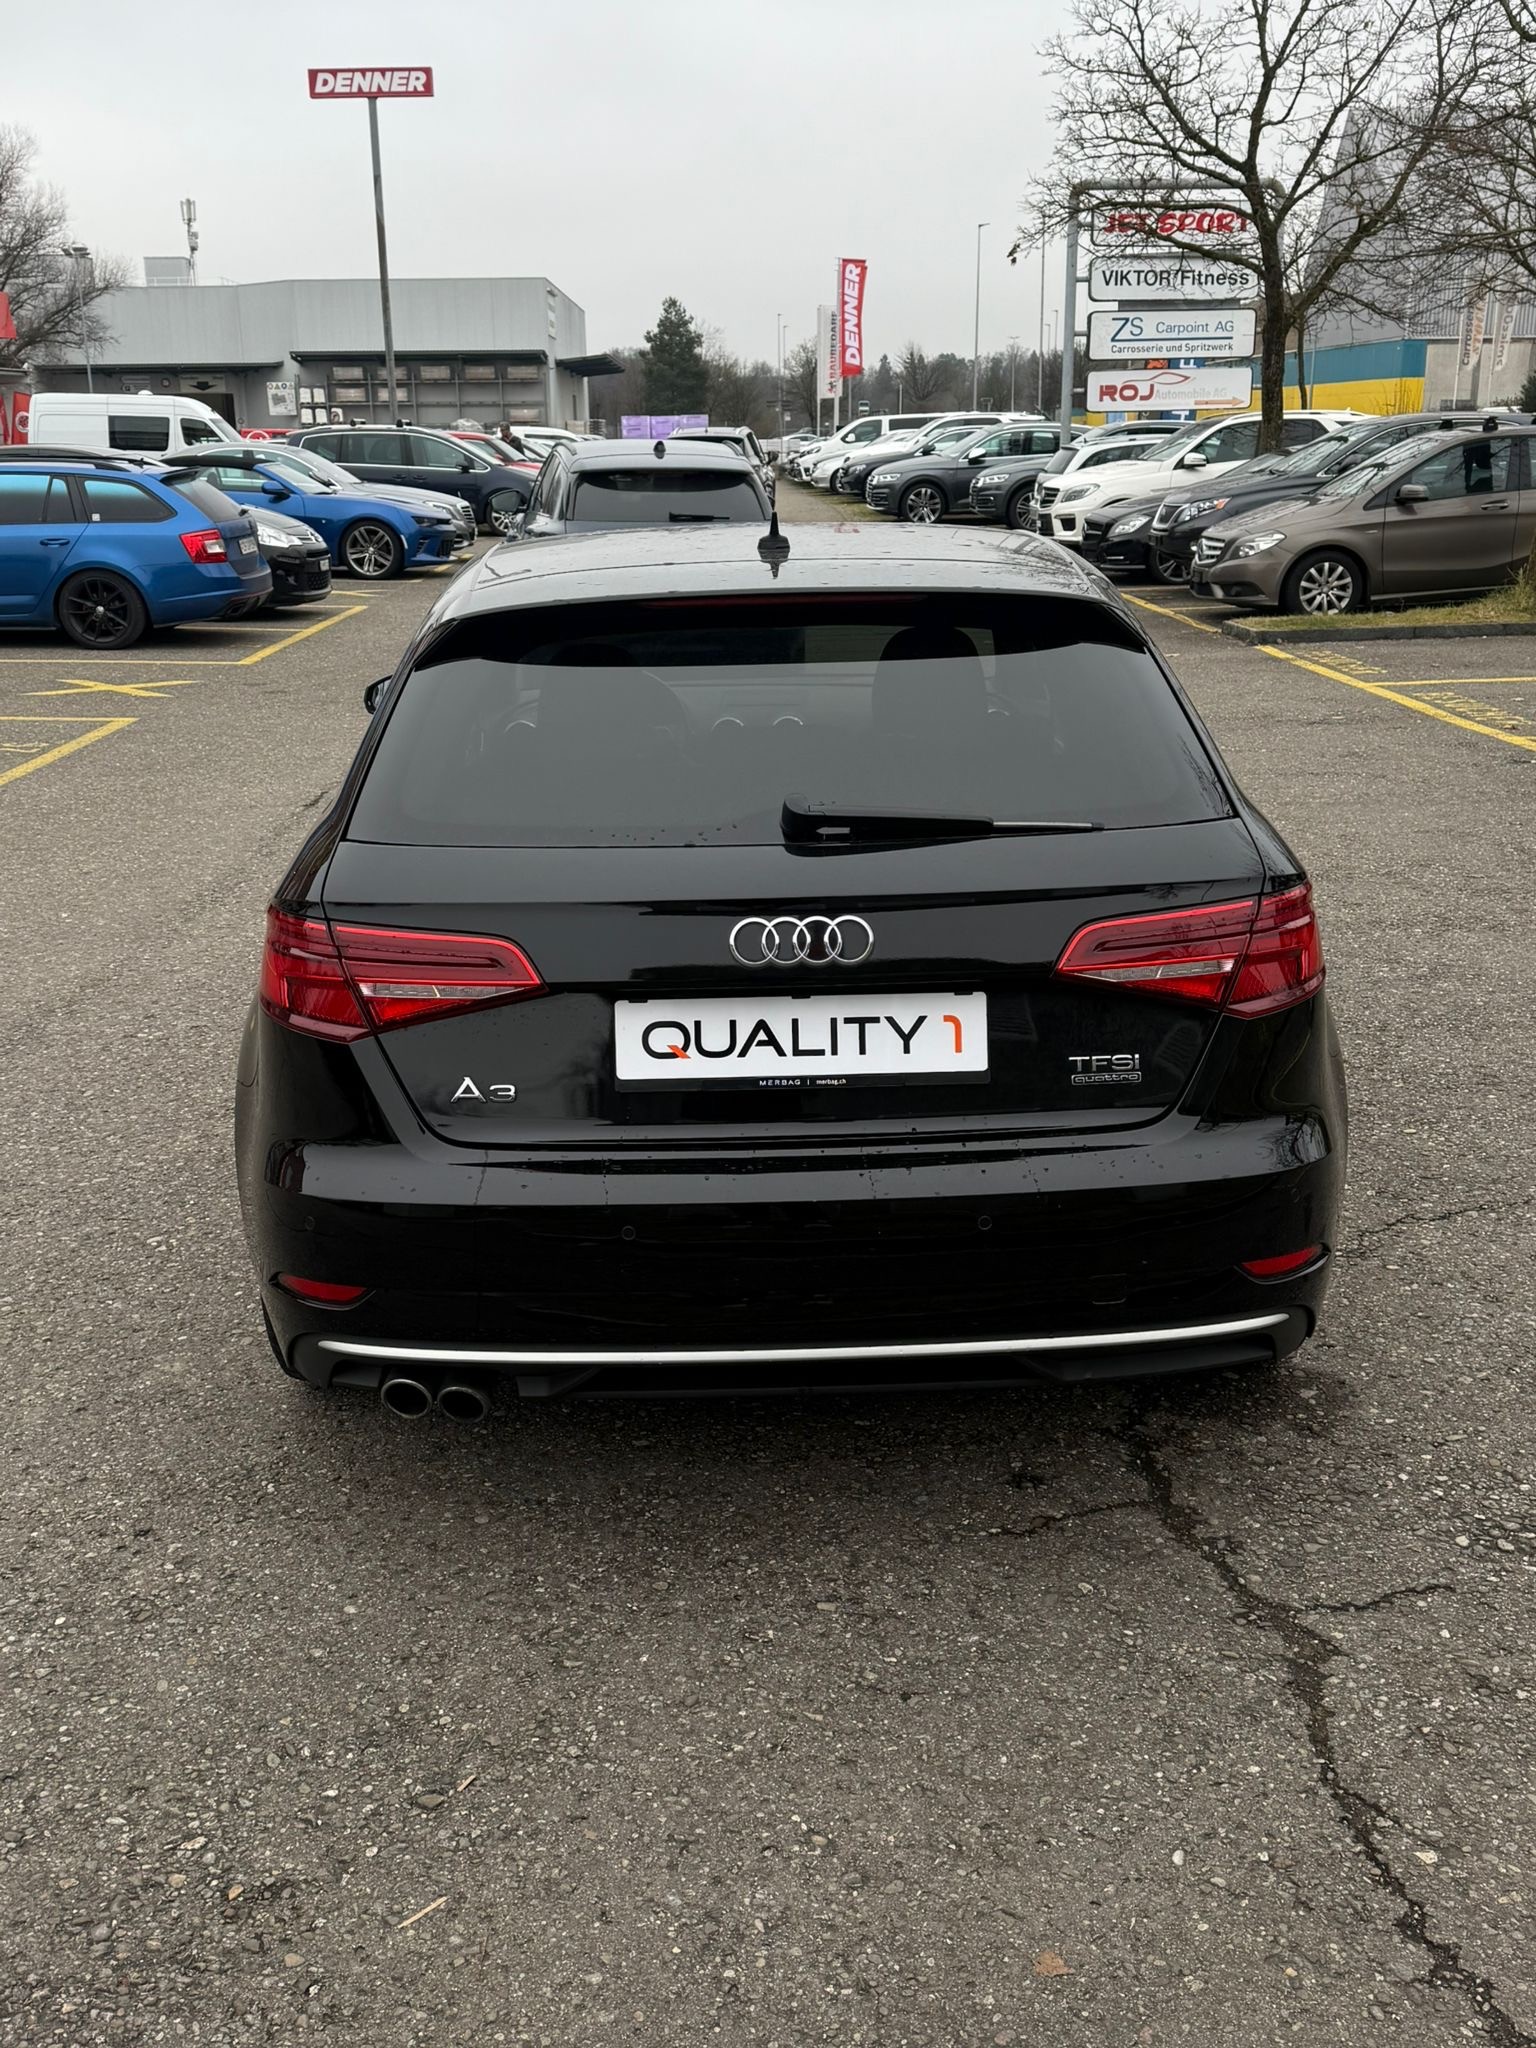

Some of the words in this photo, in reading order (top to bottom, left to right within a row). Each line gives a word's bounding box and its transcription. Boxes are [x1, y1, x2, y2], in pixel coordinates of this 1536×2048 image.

[314, 71, 427, 93] DENNER
[1156, 211, 1248, 236] SPORT
[1102, 270, 1171, 286] VIKTOR
[1180, 269, 1249, 286] Fitness
[844, 263, 862, 366] DENNER
[1110, 316, 1144, 342] ZS
[1155, 320, 1209, 335] Carpoint
[1214, 320, 1234, 333] AG
[1110, 344, 1164, 354] Carrosserie
[1165, 344, 1182, 353] und
[1184, 342, 1234, 354] Spritzwerk
[1099, 383, 1155, 402] ROJ
[1155, 387, 1211, 400] Automobile
[641, 1015, 928, 1060] QUALITY
[1068, 1053, 1140, 1072] TFSI
[450, 1076, 516, 1102] A3
[1074, 1074, 1139, 1085] quattro
